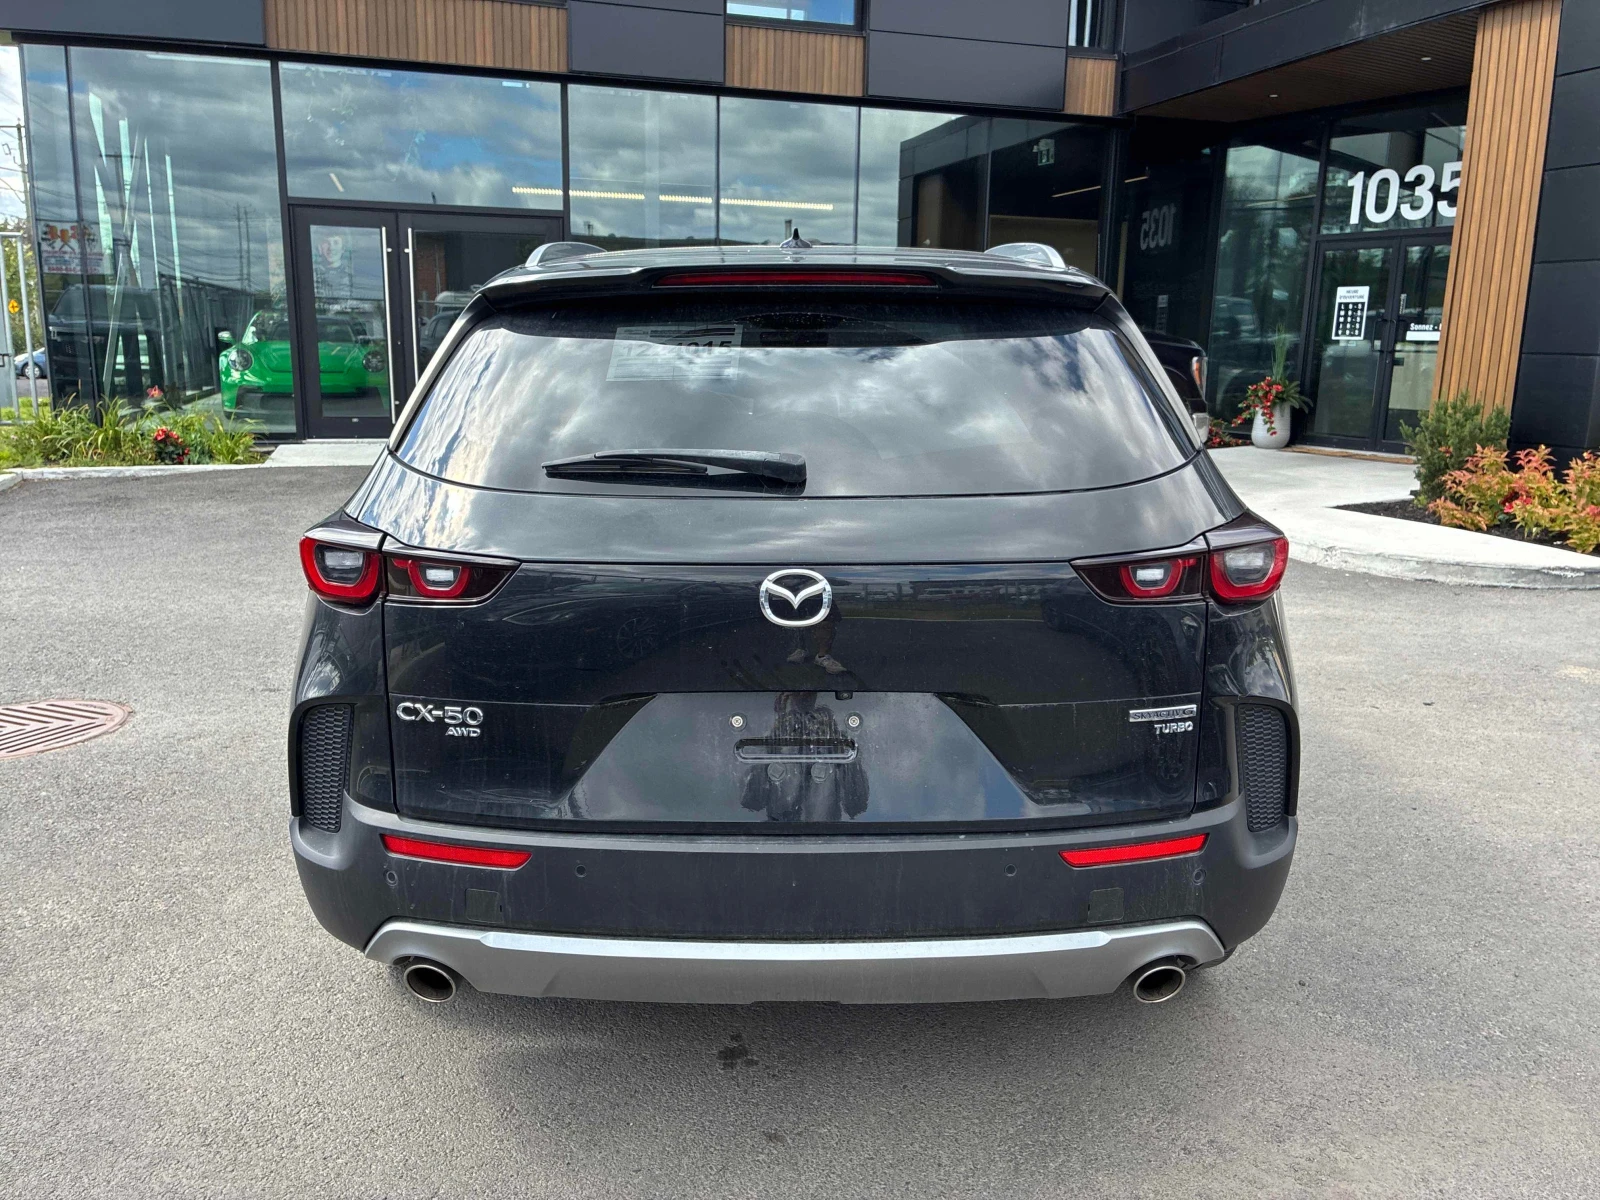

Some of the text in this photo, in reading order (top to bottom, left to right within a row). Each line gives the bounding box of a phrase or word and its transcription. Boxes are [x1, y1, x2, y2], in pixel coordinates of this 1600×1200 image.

[1347, 161, 1463, 225] 1035
[1410, 322, 1434, 331] Sonnez
[396, 702, 484, 726] CX-50
[445, 726, 481, 737] AWD
[1154, 721, 1194, 734] TURBO
